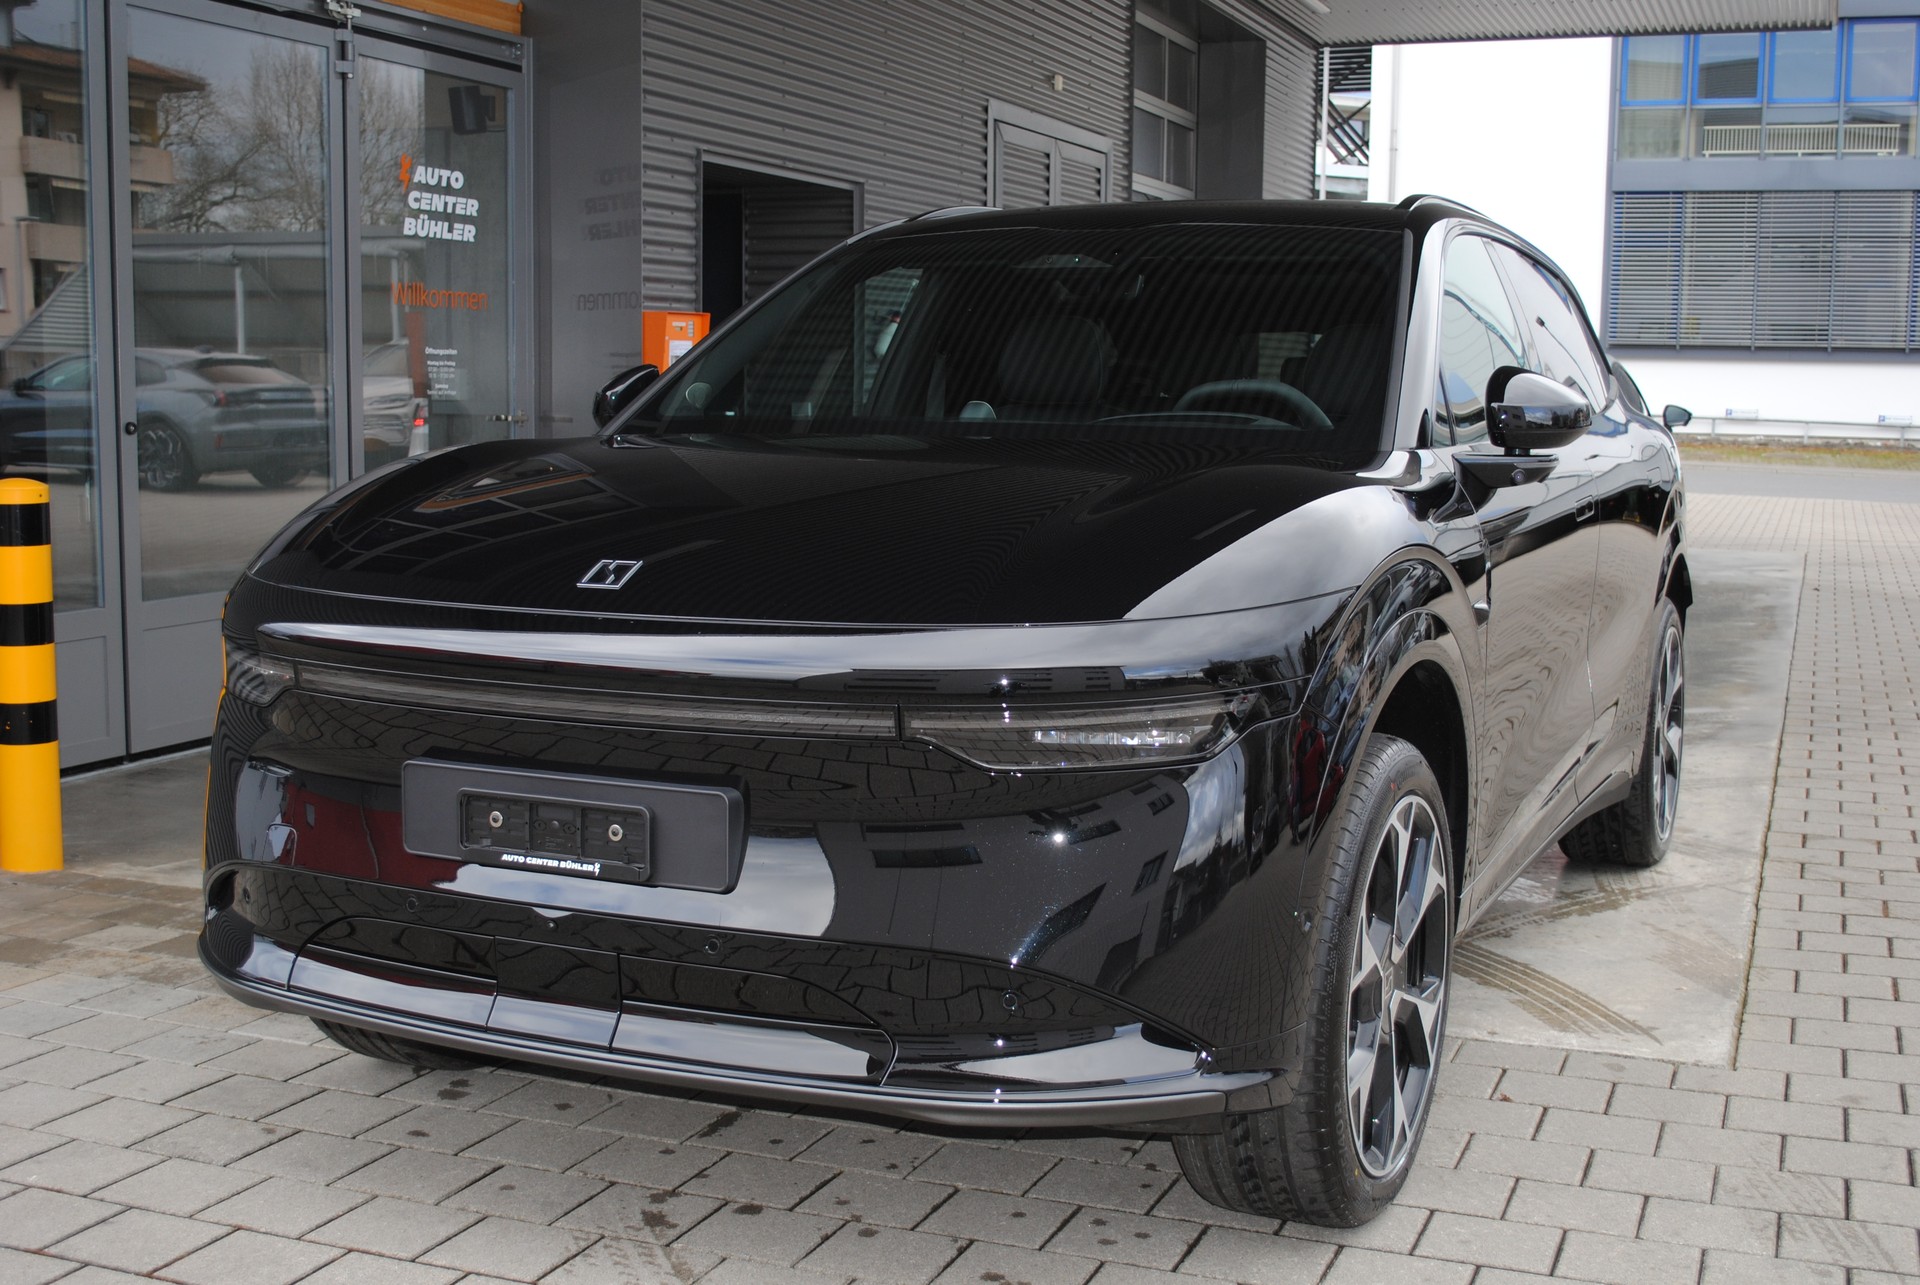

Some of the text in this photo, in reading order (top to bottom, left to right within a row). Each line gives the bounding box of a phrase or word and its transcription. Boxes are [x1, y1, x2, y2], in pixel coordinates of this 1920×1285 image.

[413, 165, 465, 190] AUTO
[407, 190, 479, 217] CENTER
[403, 214, 476, 242] BÜHLER
[391, 282, 488, 311] Willkommen
[501, 854, 594, 871] AUTO CENTER BÜHLER
